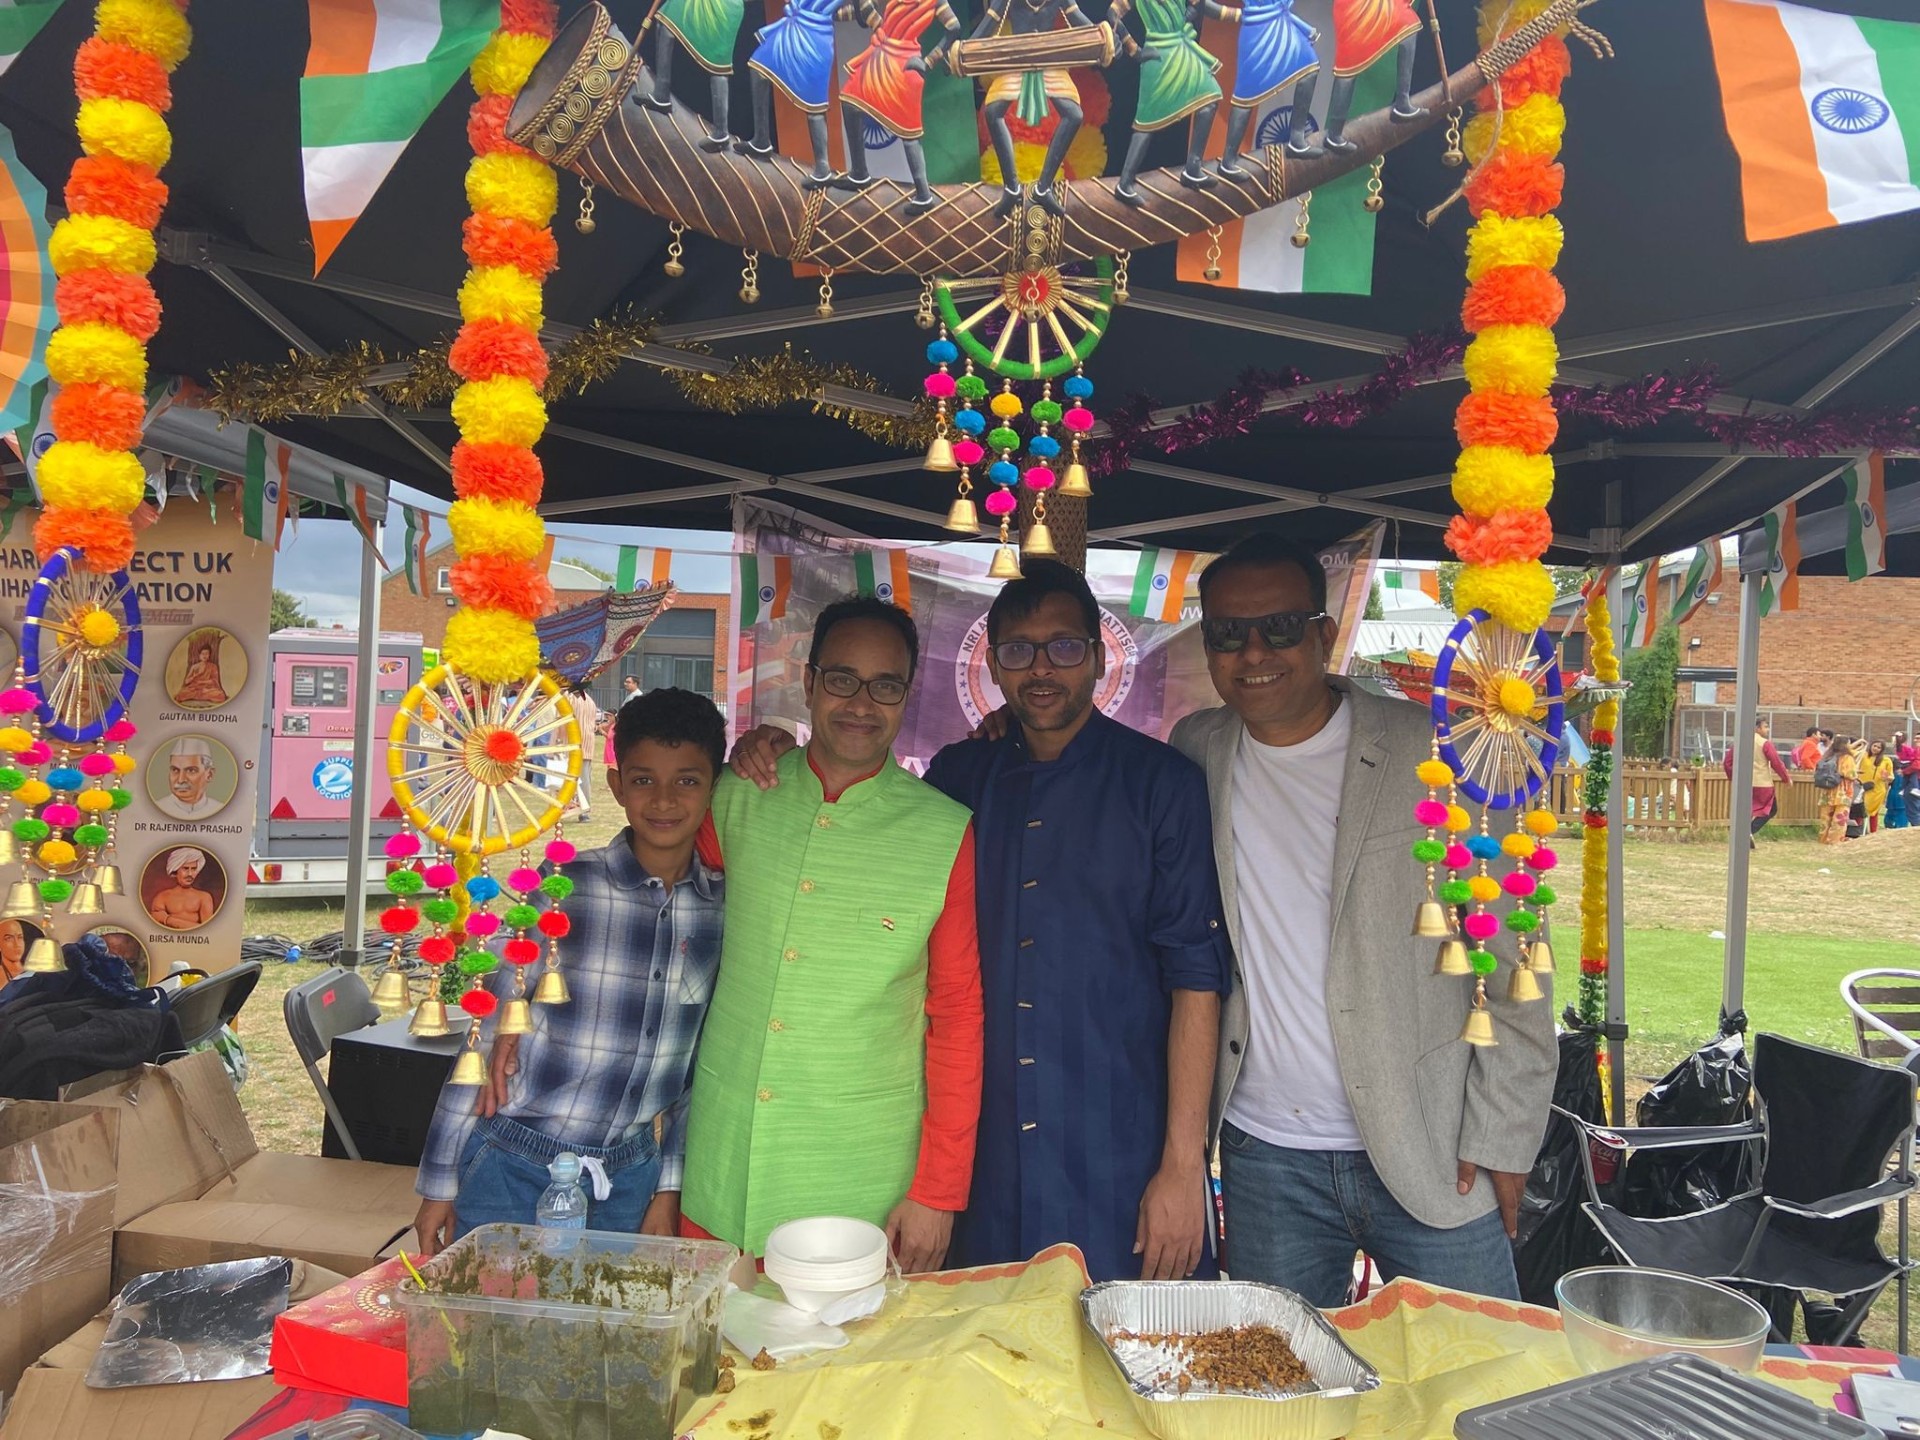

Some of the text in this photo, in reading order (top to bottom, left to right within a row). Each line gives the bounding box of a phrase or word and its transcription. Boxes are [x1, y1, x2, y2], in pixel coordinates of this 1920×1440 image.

[193, 552, 233, 574] UK
[962, 629, 980, 652] NRI
[159, 712, 238, 723] GAUTAM BUDDHA
[134, 822, 243, 834] DR RAJENDRA PRASHAD
[149, 934, 210, 945] BIRSA MUNDA
